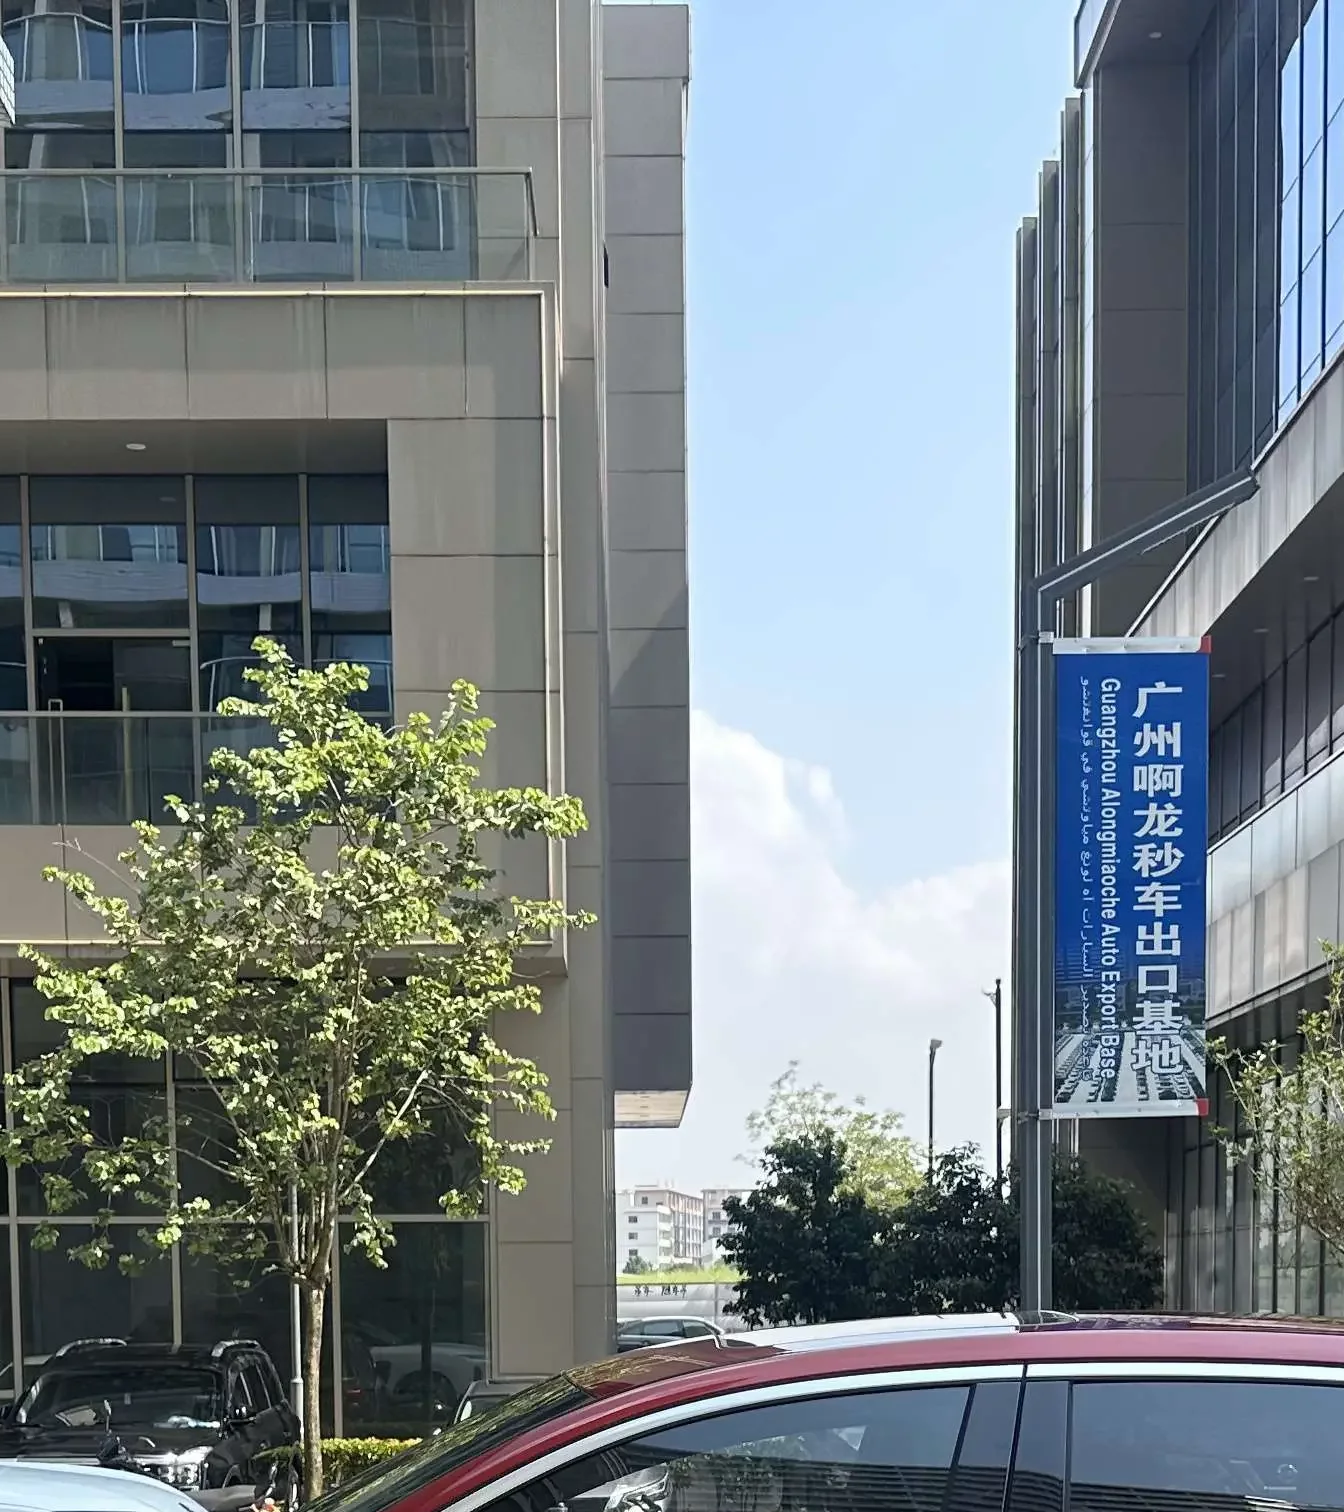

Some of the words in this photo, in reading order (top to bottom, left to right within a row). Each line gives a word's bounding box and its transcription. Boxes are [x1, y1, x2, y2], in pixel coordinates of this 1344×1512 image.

[1096, 678, 1121, 783] Guangzhou
[1096, 788, 1121, 919] Alongmiaoche
[1132, 681, 1185, 1074] 广州啊龙秒车出口基地
[1100, 923, 1121, 966] Auto
[1096, 971, 1121, 1030] Export
[1099, 1034, 1120, 1079] Base
